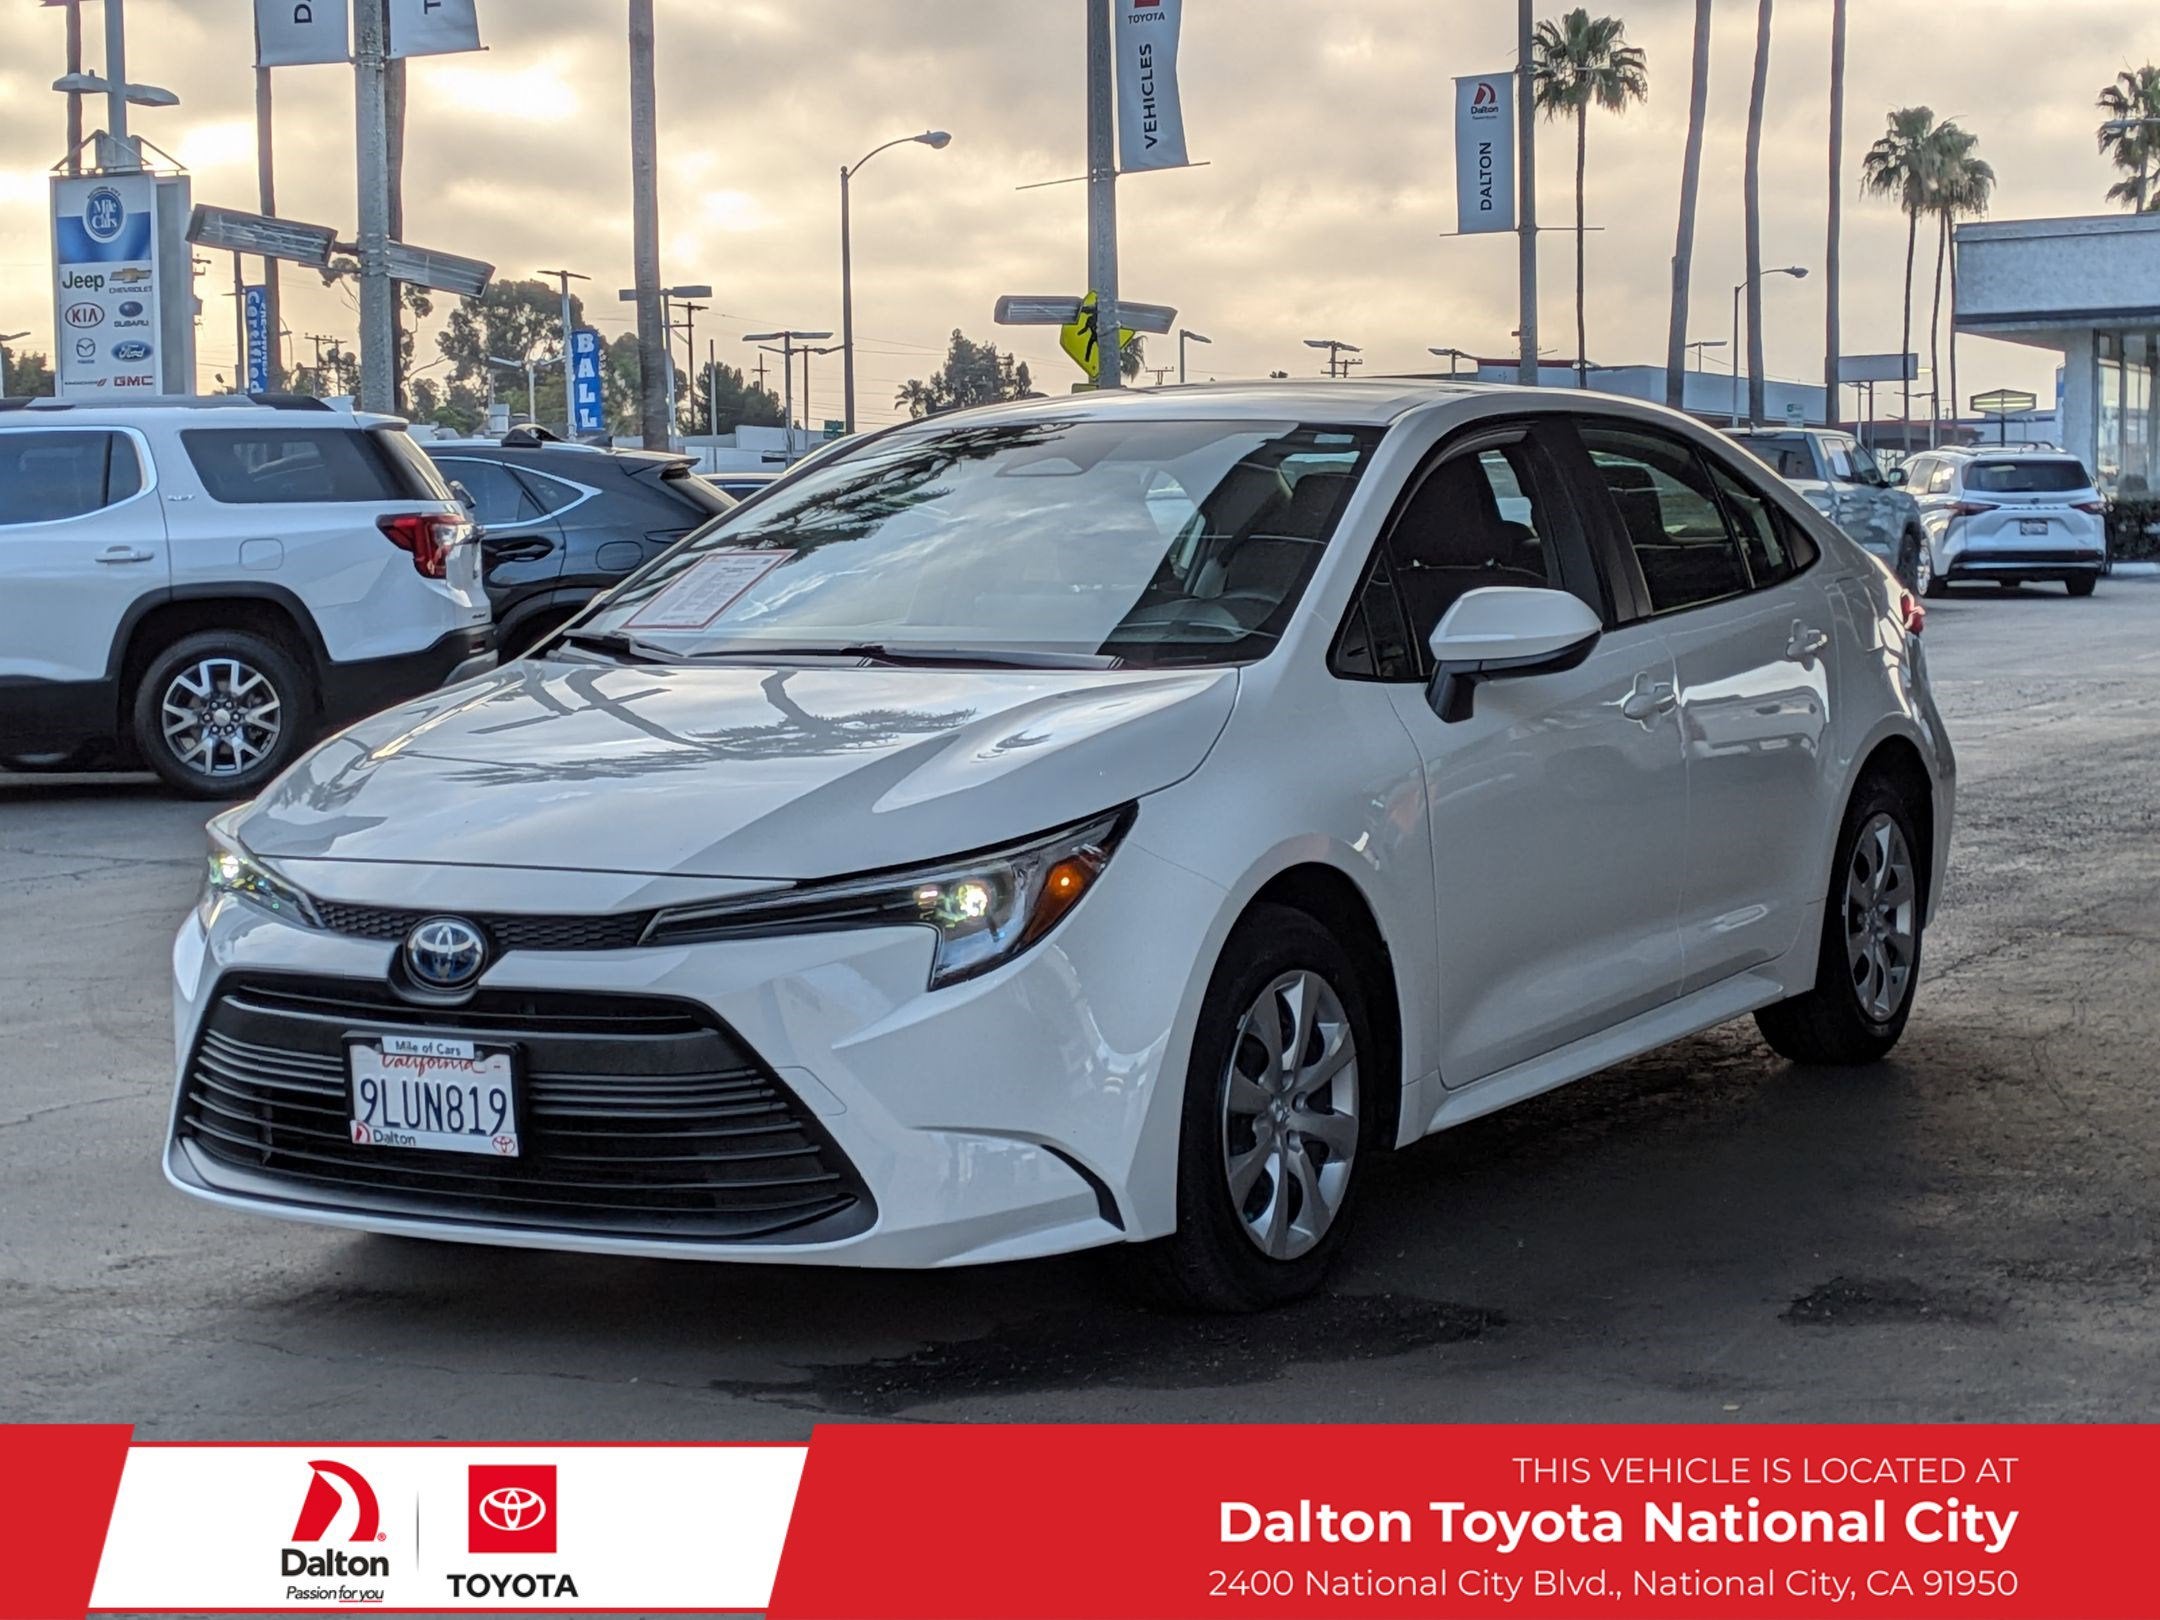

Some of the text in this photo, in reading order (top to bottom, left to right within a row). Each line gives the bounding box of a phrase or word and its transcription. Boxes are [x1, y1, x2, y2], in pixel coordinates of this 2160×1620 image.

[1128, 11, 1165, 25] TOYOTA
[1139, 43, 1158, 150] VEHICLES
[1470, 105, 1499, 115] Dalton
[1479, 142, 1492, 211] DALTON
[62, 271, 105, 292] Jeep
[72, 308, 98, 323] KIA
[113, 320, 149, 328] SUBARU
[246, 291, 264, 394] Certified
[119, 344, 146, 358] Ford
[113, 376, 154, 387] GMC
[577, 333, 598, 428] BALL
[395, 1040, 462, 1056] Mile of Cars
[360, 1078, 507, 1137] 9LUN819
[373, 1129, 417, 1146] Dalton
